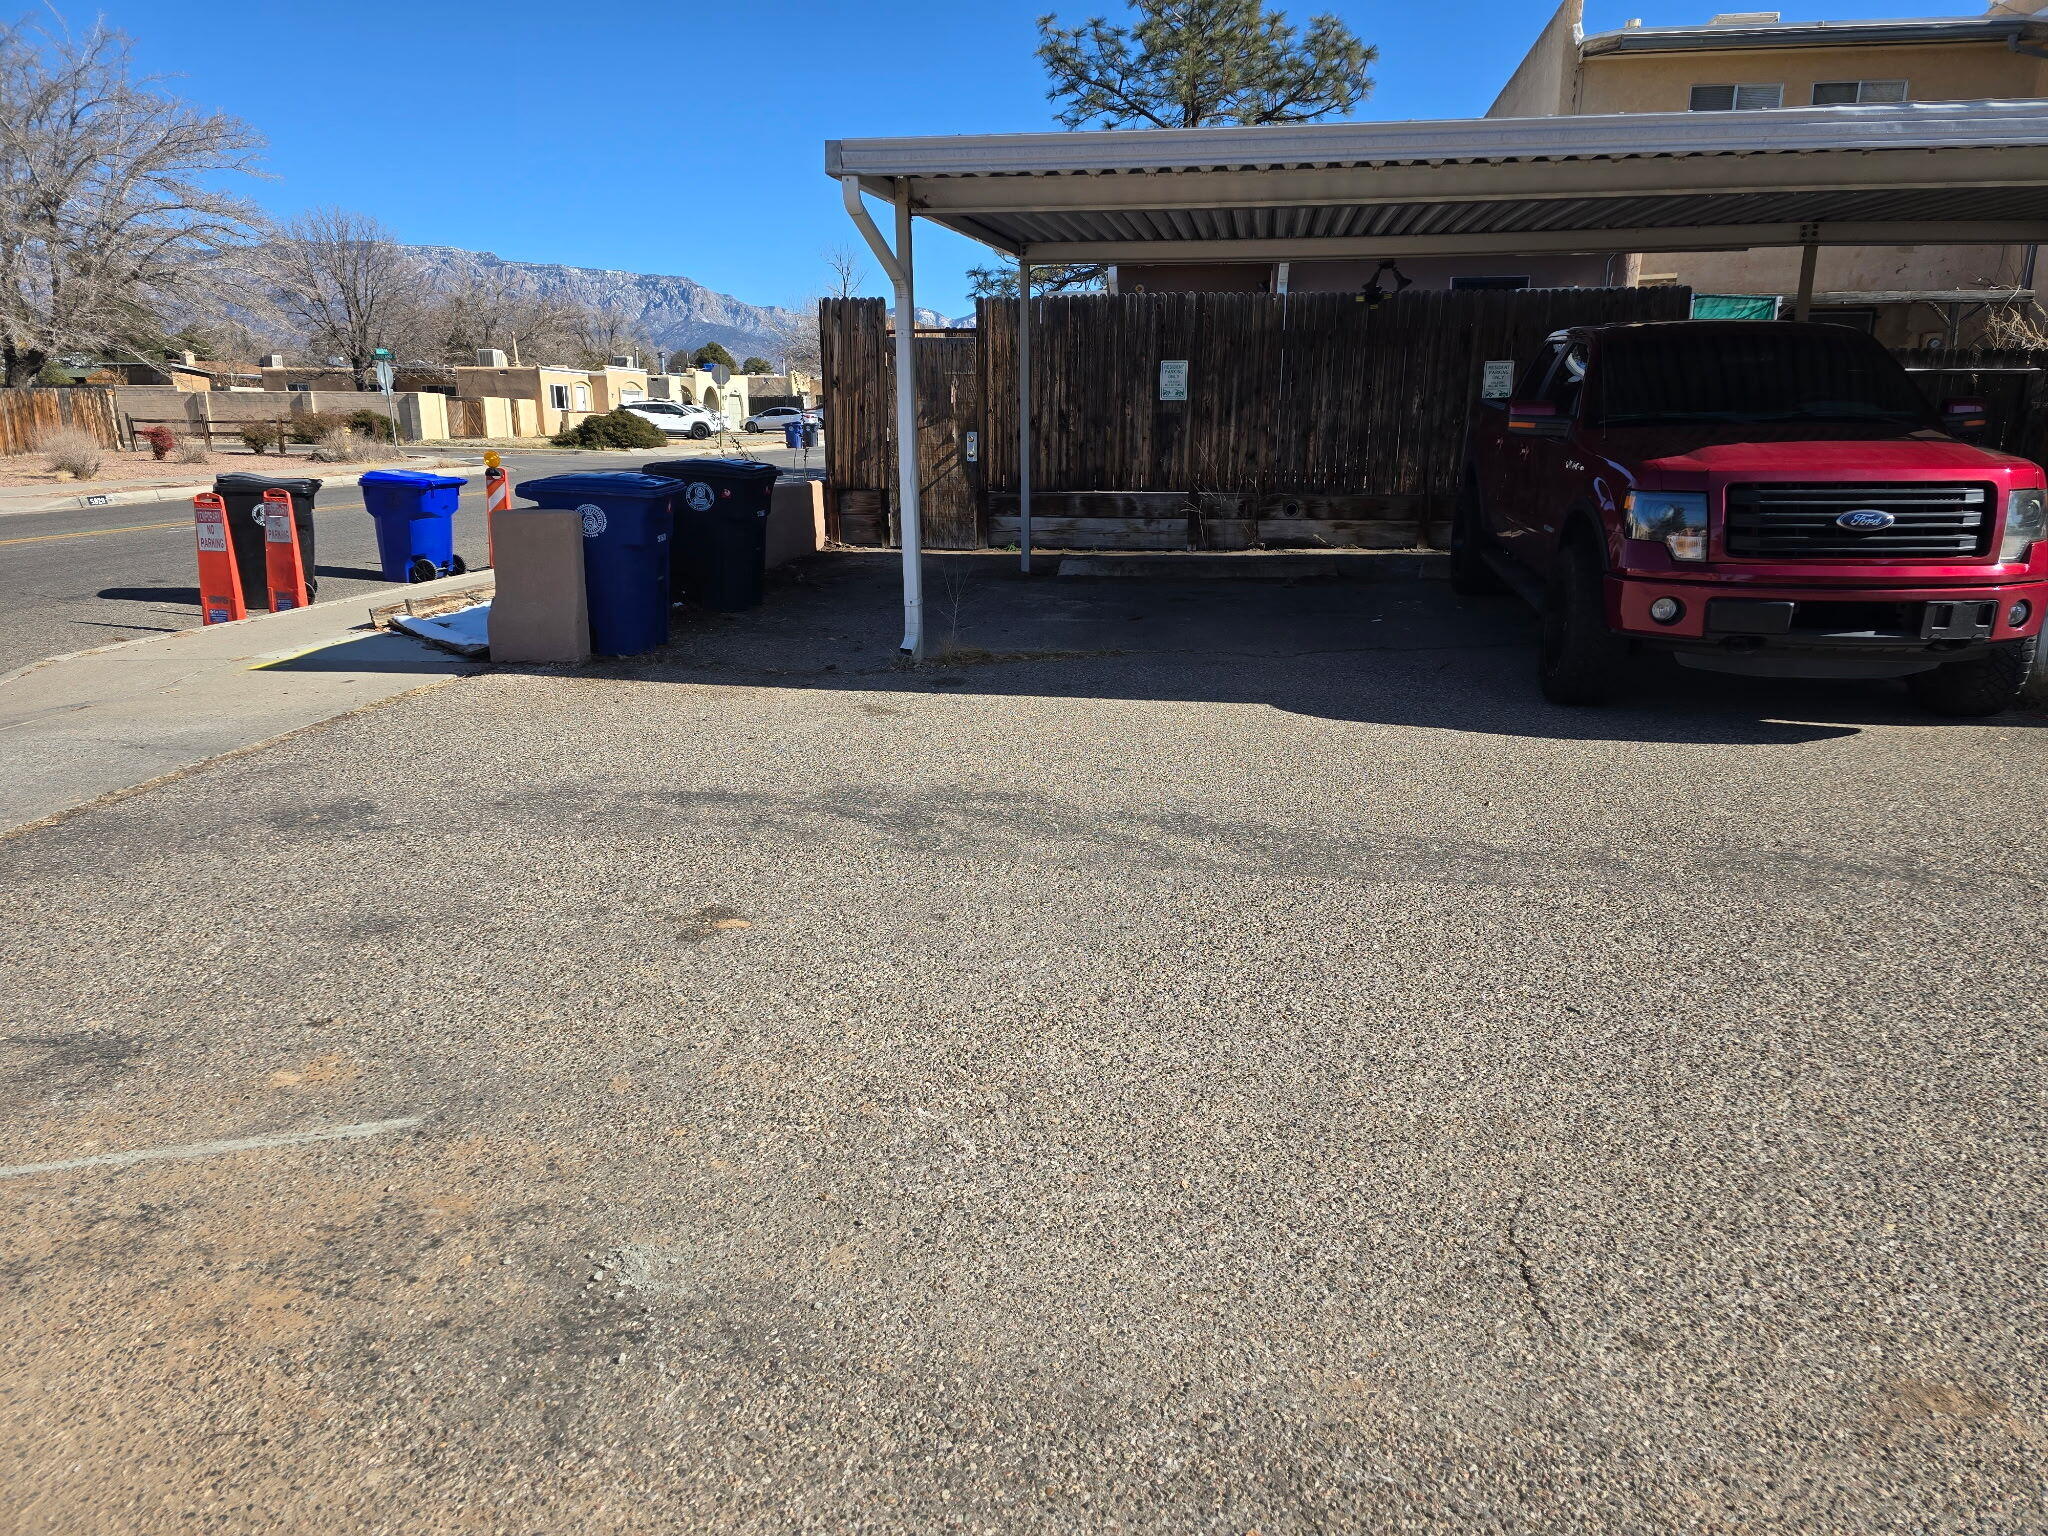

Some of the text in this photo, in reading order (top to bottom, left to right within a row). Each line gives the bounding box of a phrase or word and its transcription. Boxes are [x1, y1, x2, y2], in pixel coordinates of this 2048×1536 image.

[1850, 513, 1883, 526] Ford
[207, 524, 215, 535] NO
[201, 538, 225, 548] PARKING
